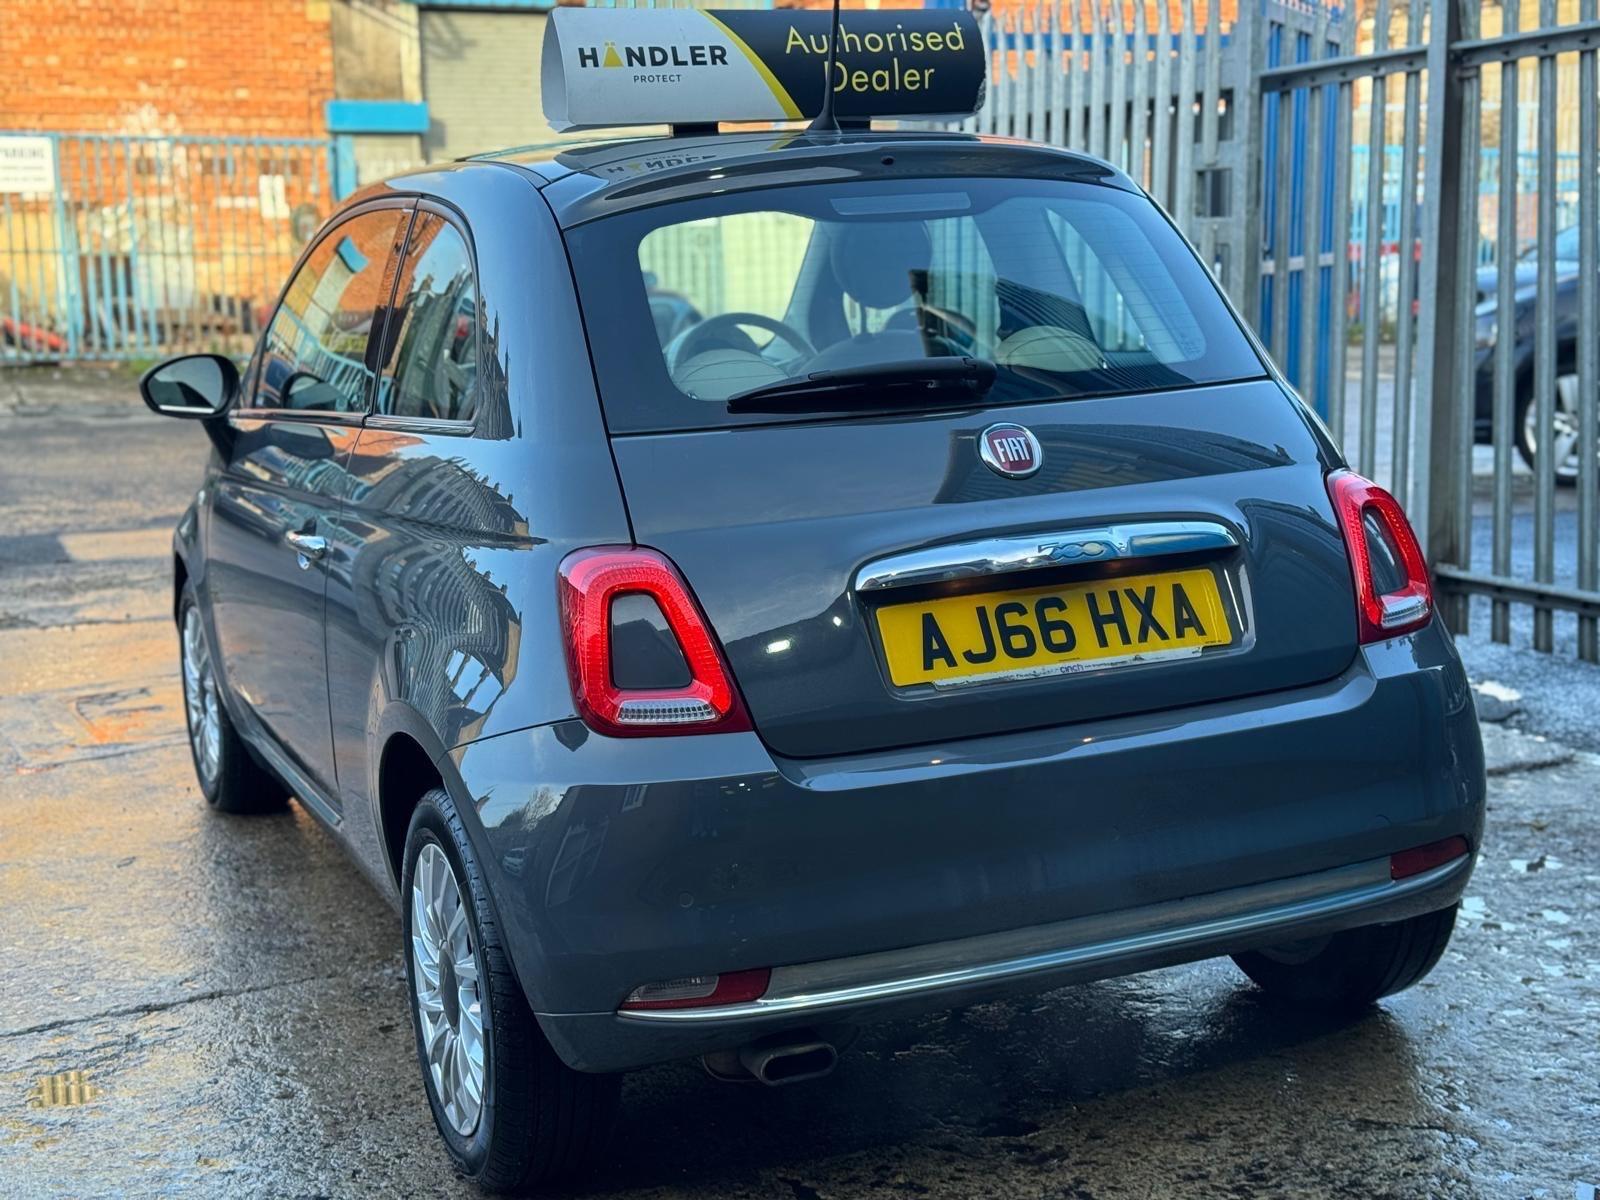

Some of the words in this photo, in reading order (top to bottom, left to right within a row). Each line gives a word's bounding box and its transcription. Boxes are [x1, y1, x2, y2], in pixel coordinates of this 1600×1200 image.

[633, 74, 681, 83] PROTECT
[824, 57, 935, 92] Dealer
[993, 437, 1030, 463] FIAT
[1038, 541, 1104, 561] 500
[922, 596, 1076, 671] AJ66
[1085, 583, 1207, 649] HXA
[1060, 663, 1084, 674] cinch
